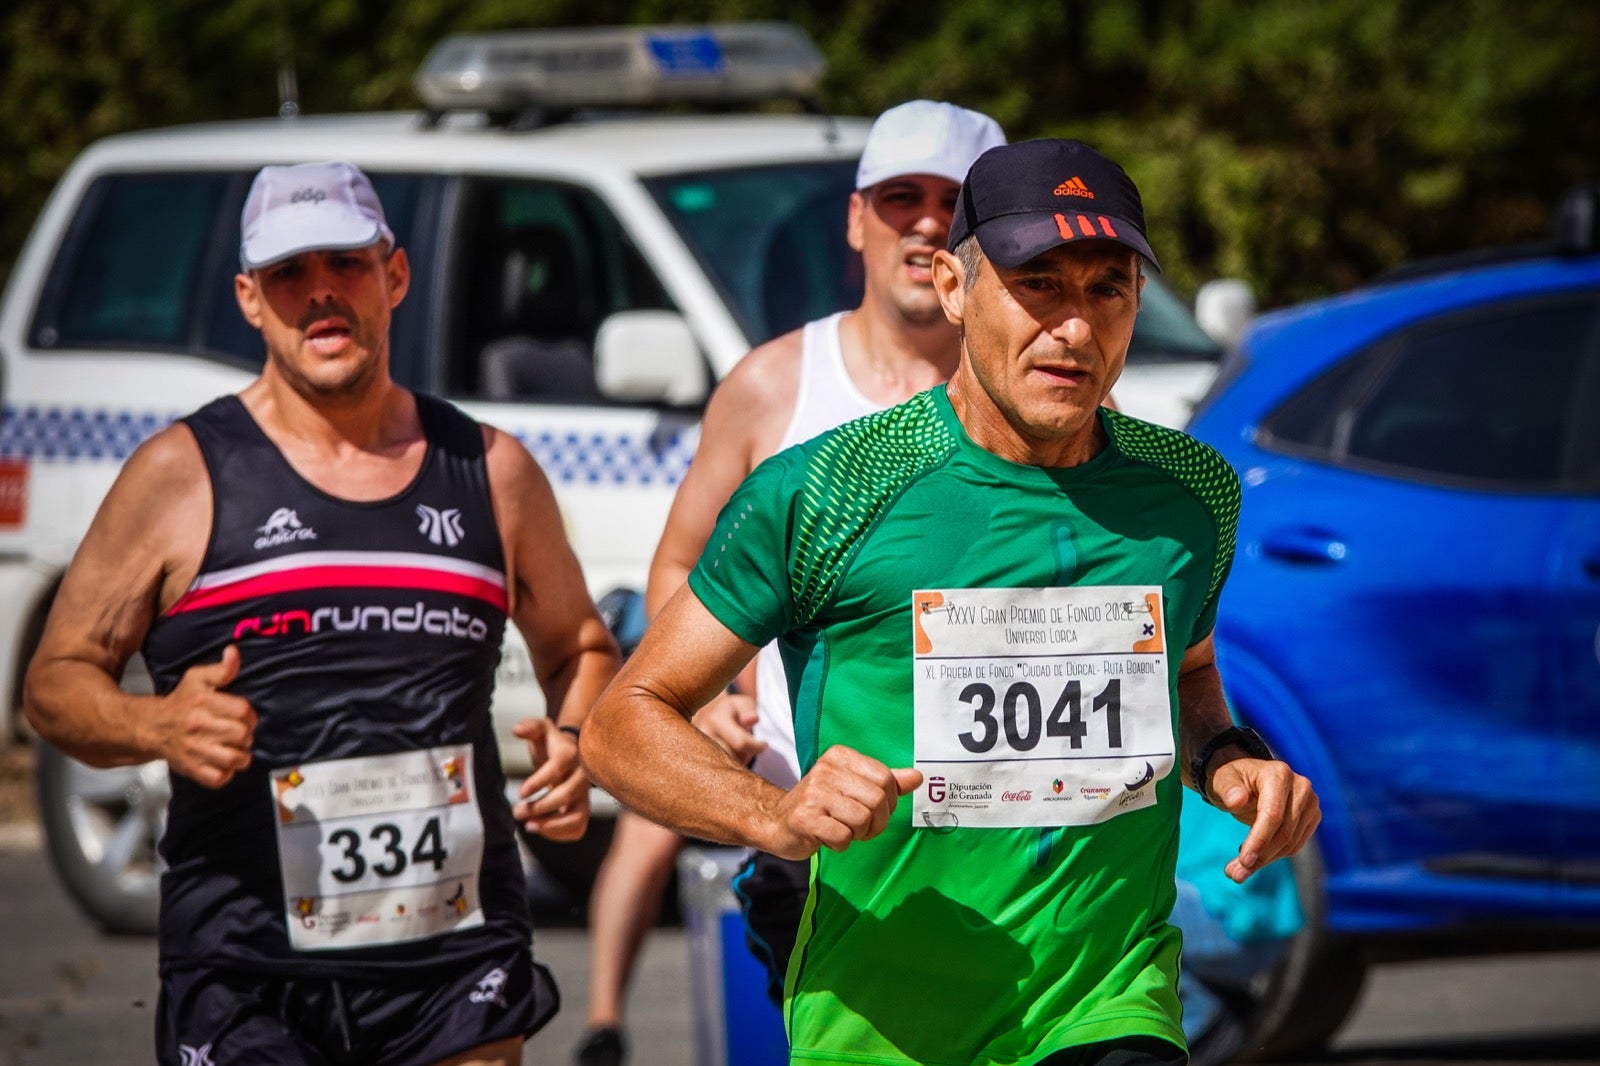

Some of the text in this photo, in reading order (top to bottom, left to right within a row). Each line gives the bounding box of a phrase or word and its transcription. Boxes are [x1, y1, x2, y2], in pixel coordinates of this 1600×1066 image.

[1053, 187, 1095, 200] adidas
[946, 605, 976, 625] XXXV
[980, 605, 1007, 625] GRAN
[1010, 605, 1046, 624] PREMIO
[1050, 607, 1063, 624] DE
[1067, 603, 1101, 623] FONDO
[1005, 627, 1078, 645] UNIVERSO LORCA
[925, 665, 936, 680] XL
[940, 664, 973, 679] PRUEBA
[975, 665, 986, 679] DE
[988, 663, 1015, 679] FONDO
[1053, 664, 1063, 677] DE
[1103, 660, 1124, 675] RUTA
[957, 678, 1122, 754] 3041
[948, 791, 992, 800] de Granada
[949, 782, 992, 792] Diputación
[327, 815, 448, 884] 334
